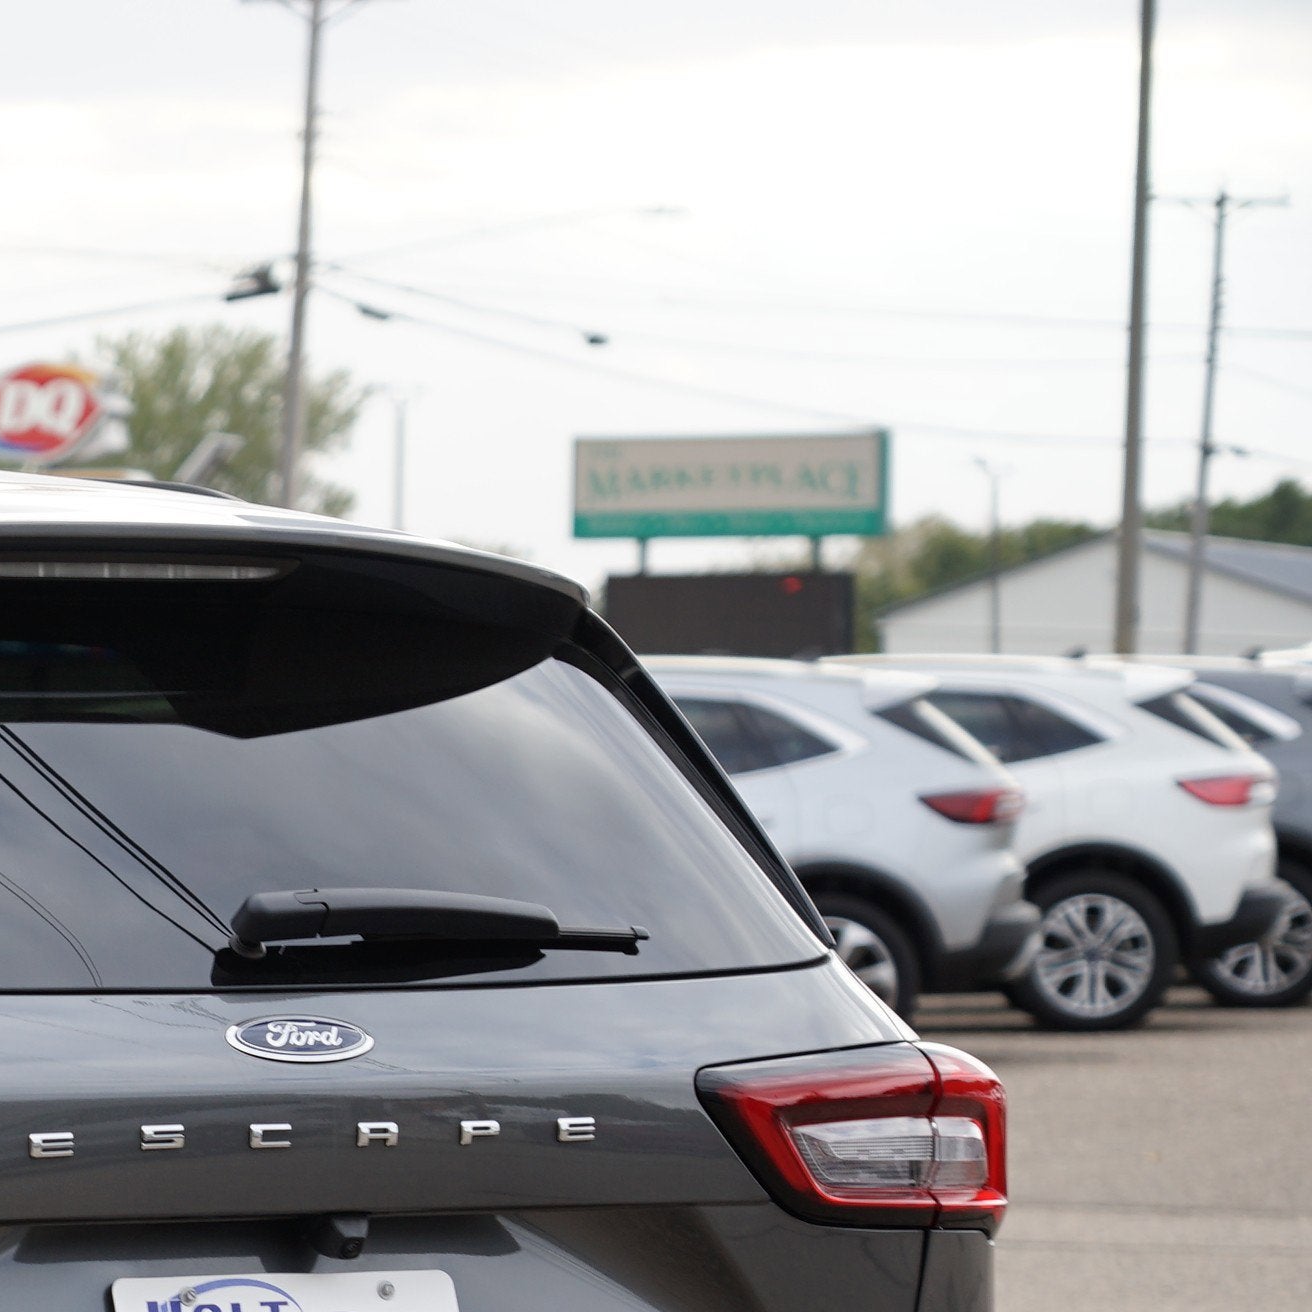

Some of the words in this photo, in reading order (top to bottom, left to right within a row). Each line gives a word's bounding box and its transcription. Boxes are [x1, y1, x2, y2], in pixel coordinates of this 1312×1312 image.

[587, 462, 860, 498] MARKETPLACE
[265, 1021, 343, 1048] Ford
[29, 1116, 596, 1158] ESCAPE
